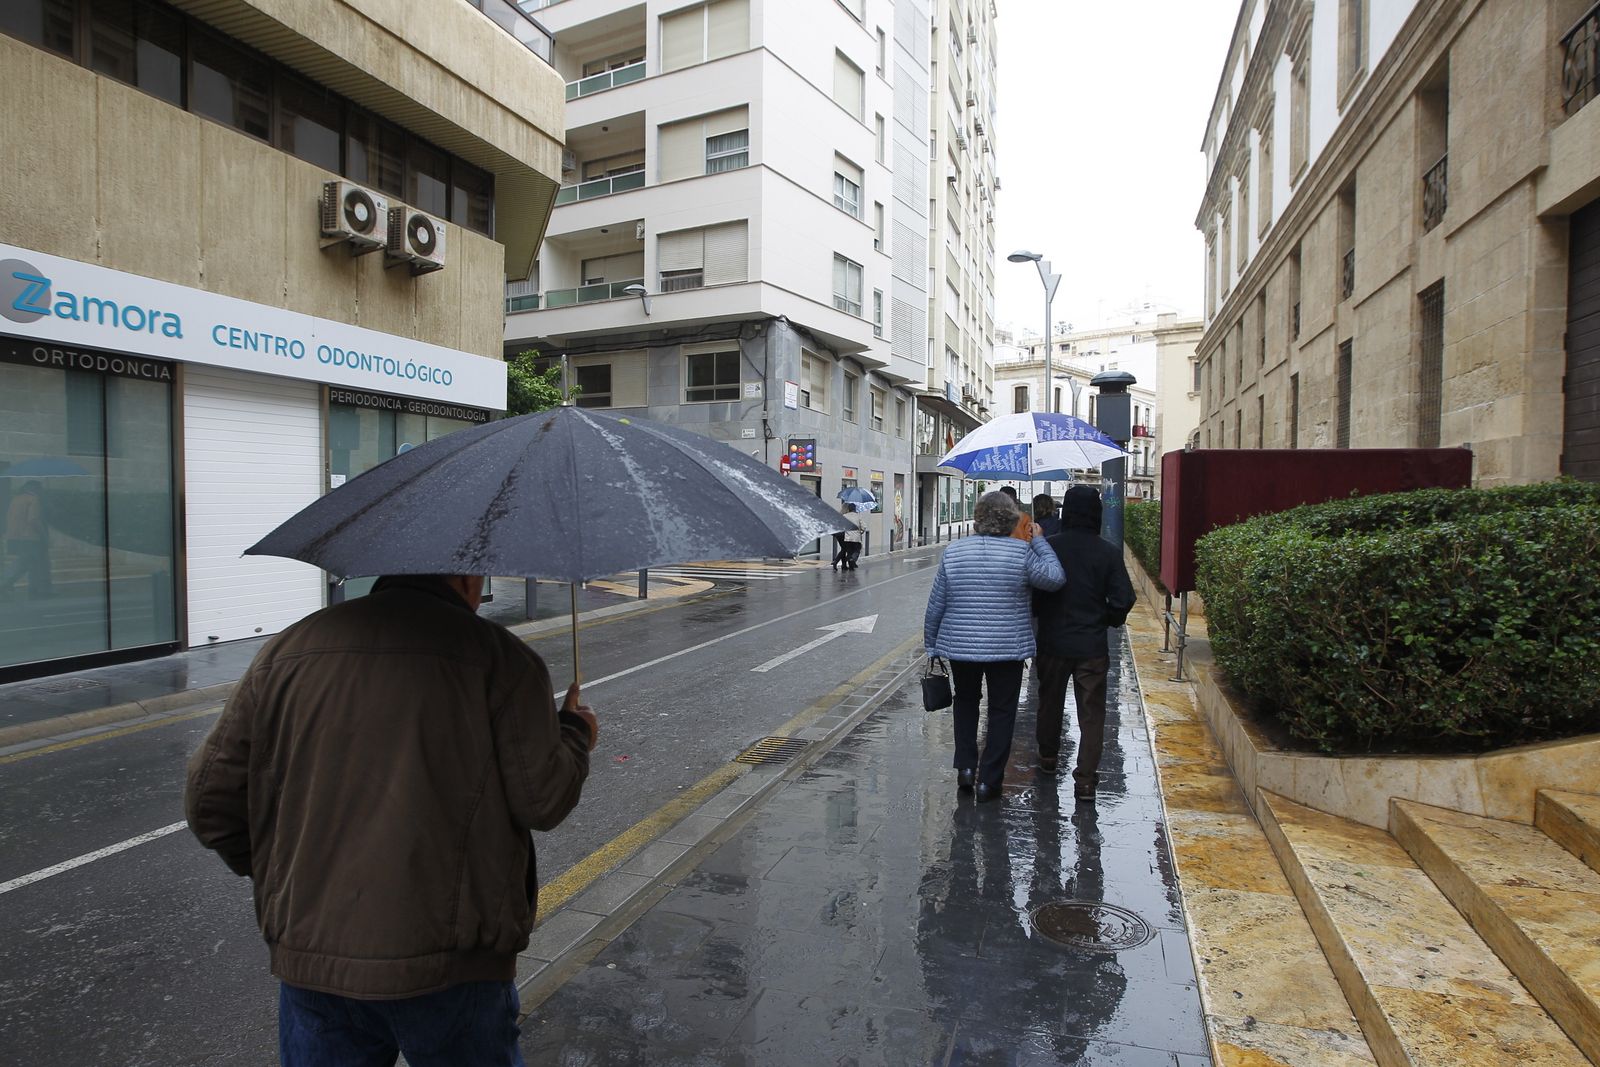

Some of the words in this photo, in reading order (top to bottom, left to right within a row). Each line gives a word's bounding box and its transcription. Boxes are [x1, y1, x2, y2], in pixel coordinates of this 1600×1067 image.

[12, 271, 184, 339] Zamora
[32, 347, 171, 379] ORTODONCIA
[212, 324, 305, 360] CENTRO
[317, 345, 453, 386] ODONTOLÓGICO
[330, 390, 401, 410] PERIODONCIA
